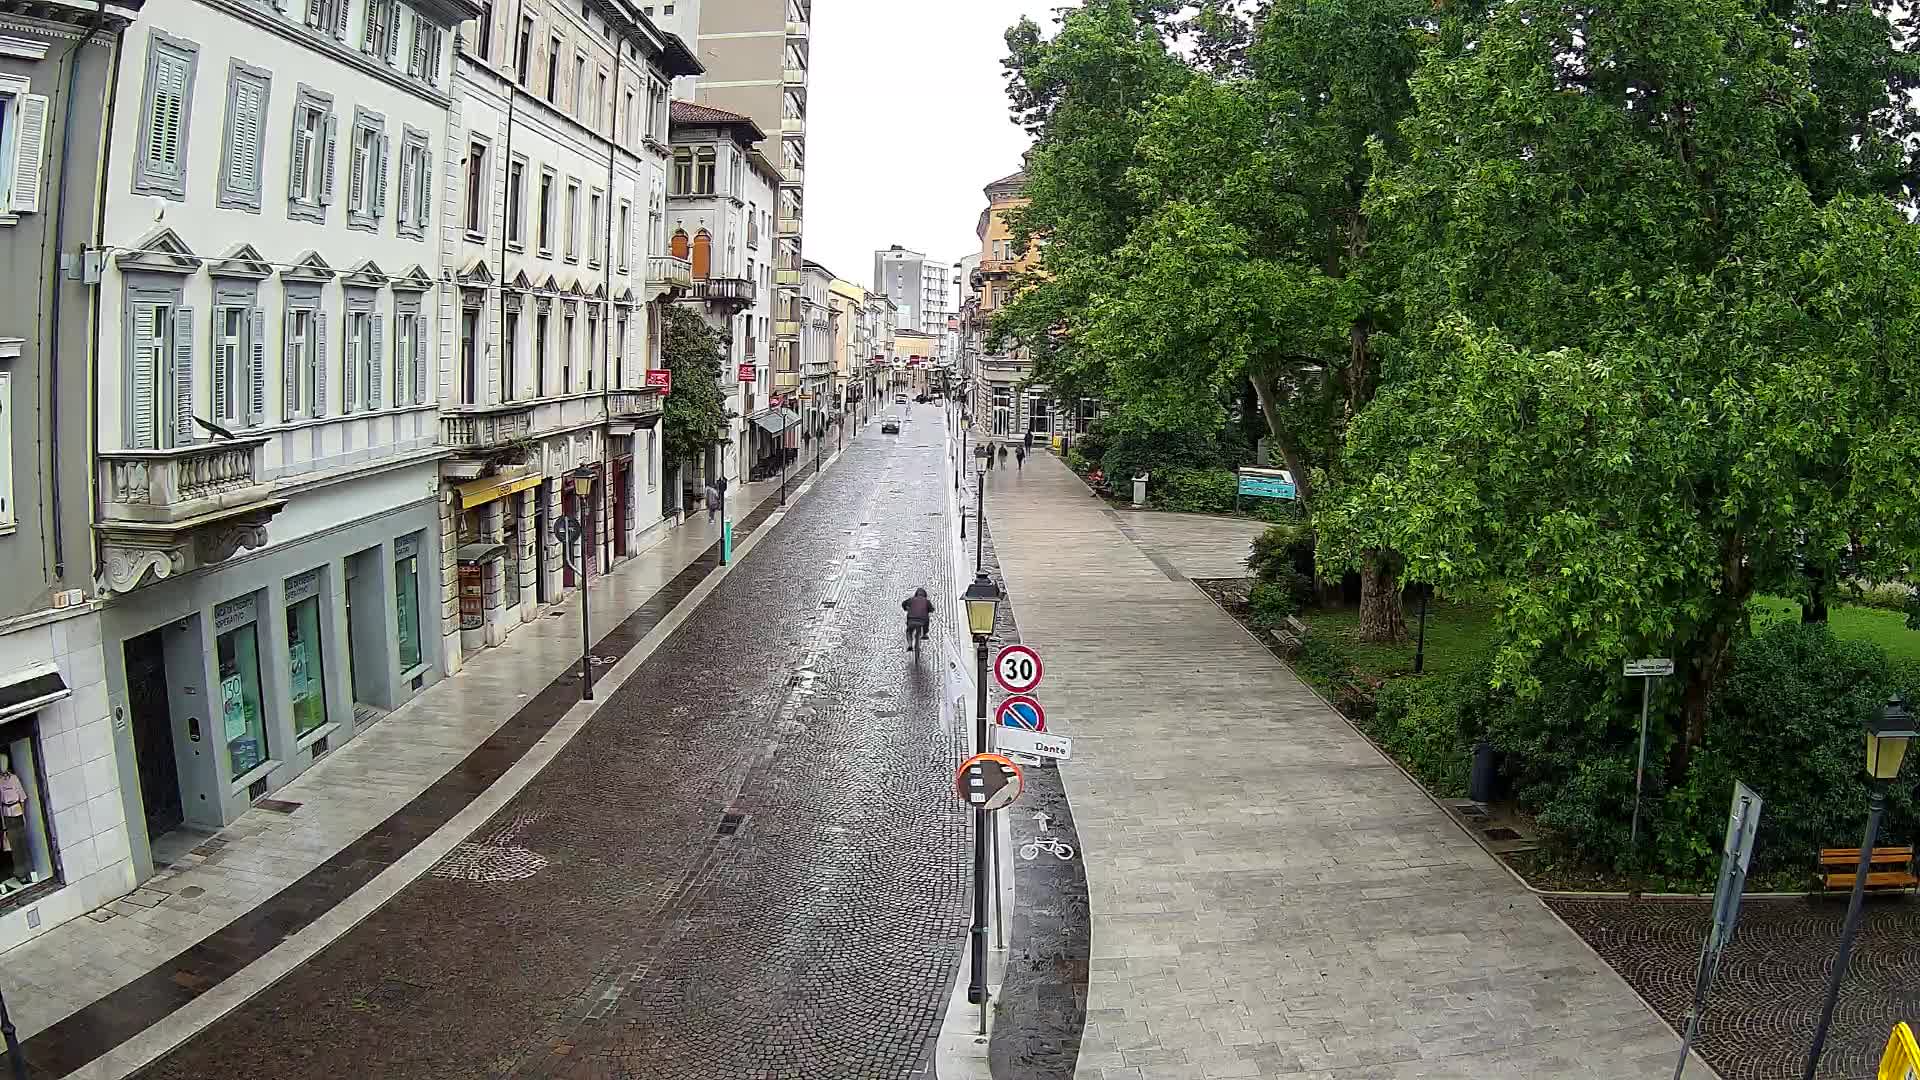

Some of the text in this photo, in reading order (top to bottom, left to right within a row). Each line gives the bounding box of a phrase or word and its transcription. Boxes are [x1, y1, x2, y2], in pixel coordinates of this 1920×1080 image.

[1005, 658, 1033, 680] 30
[223, 678, 240, 699] 130
[1035, 742, 1066, 755] Dante
